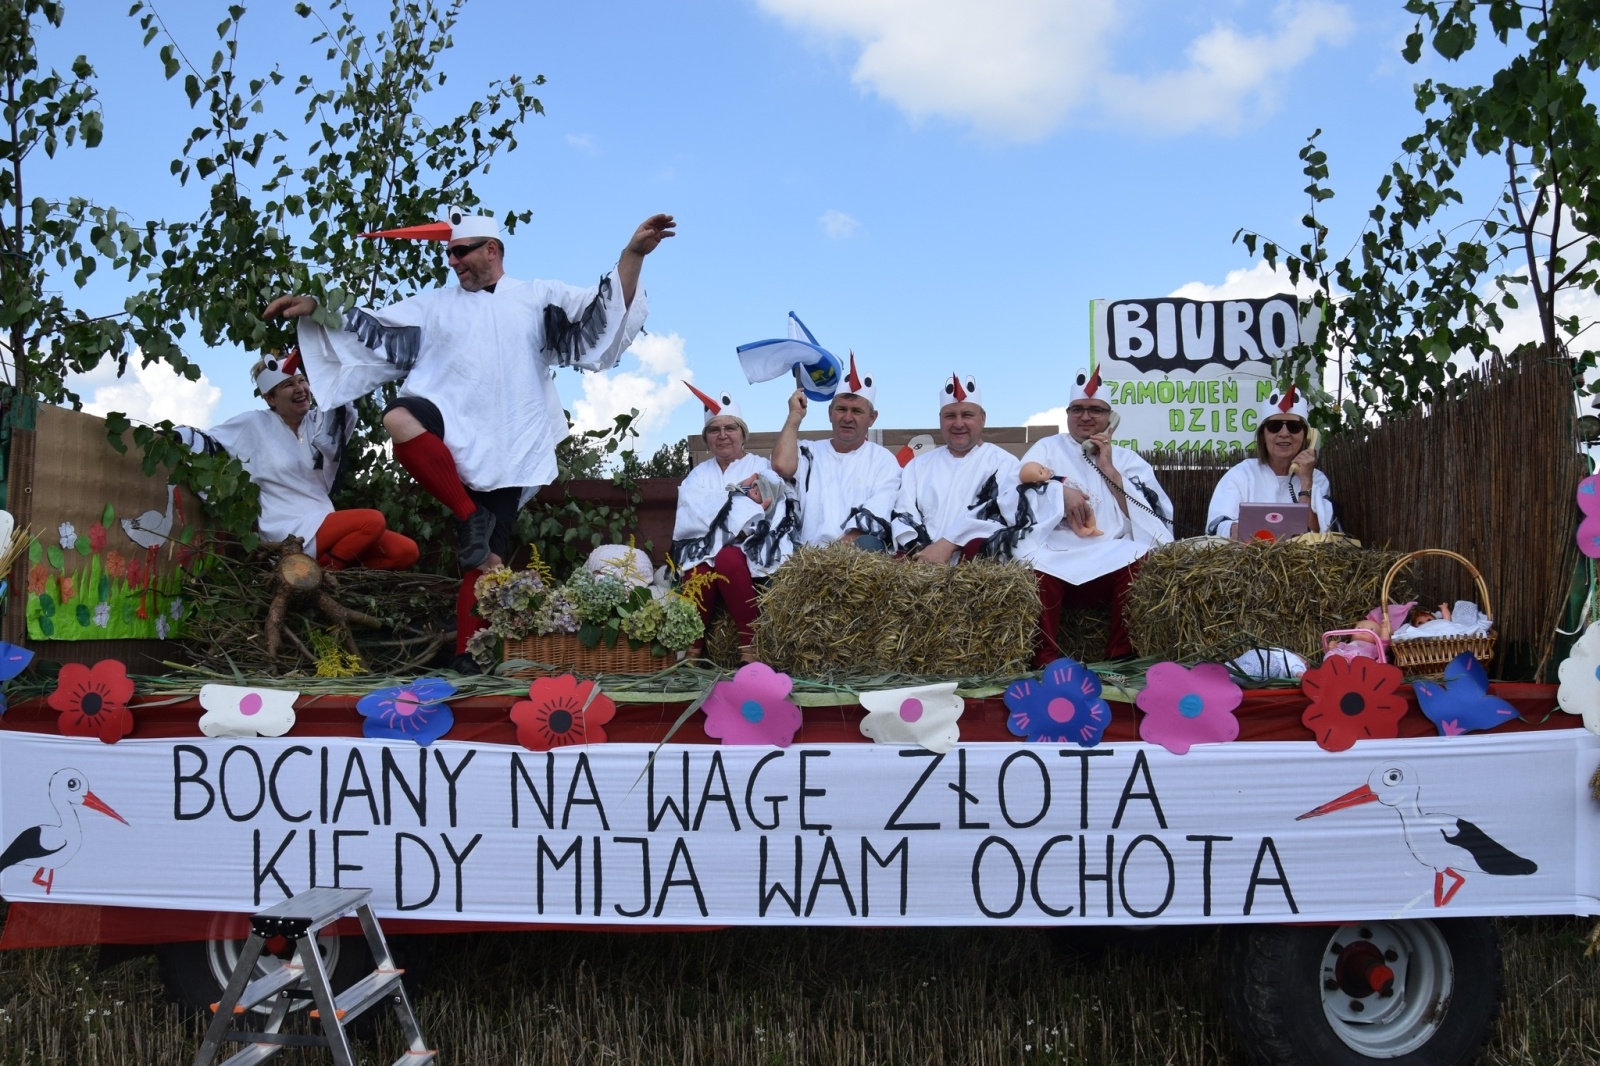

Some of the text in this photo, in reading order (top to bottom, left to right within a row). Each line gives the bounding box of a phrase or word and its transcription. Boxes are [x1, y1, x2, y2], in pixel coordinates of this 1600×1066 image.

[1112, 299, 1299, 362] BIURO
[1103, 375, 1238, 404] ZAMÓWIEŃ
[173, 744, 1169, 837] BOCIANY NA WAGĘ ZŁOTA
[253, 828, 1300, 920] KIEDY MIJA WAM OCHOTA
